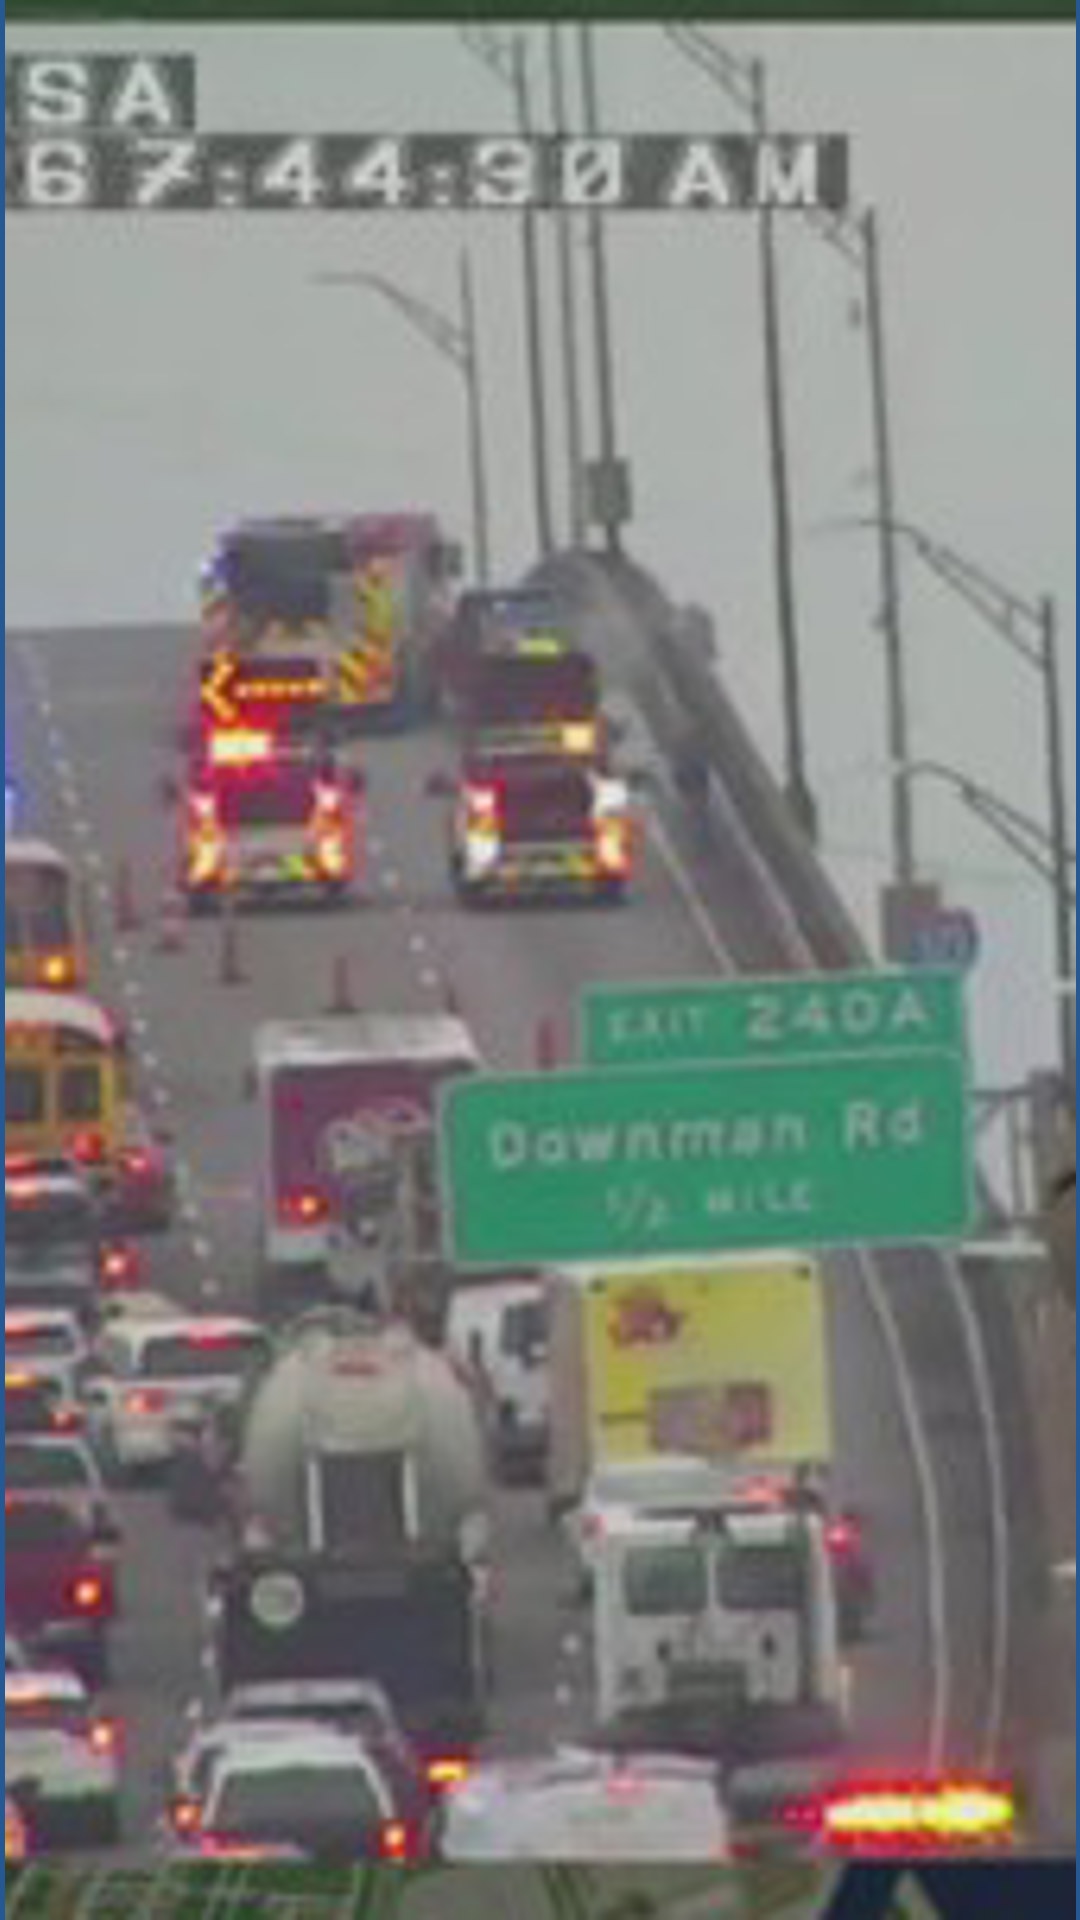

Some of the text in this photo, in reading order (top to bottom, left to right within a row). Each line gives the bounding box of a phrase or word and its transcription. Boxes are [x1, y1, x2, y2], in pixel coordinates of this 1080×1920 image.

[607, 986, 926, 1044] EXIT 240A
[490, 1111, 809, 1170] Downman
[846, 1098, 923, 1152] Rd
[706, 1177, 811, 1213] MILE
